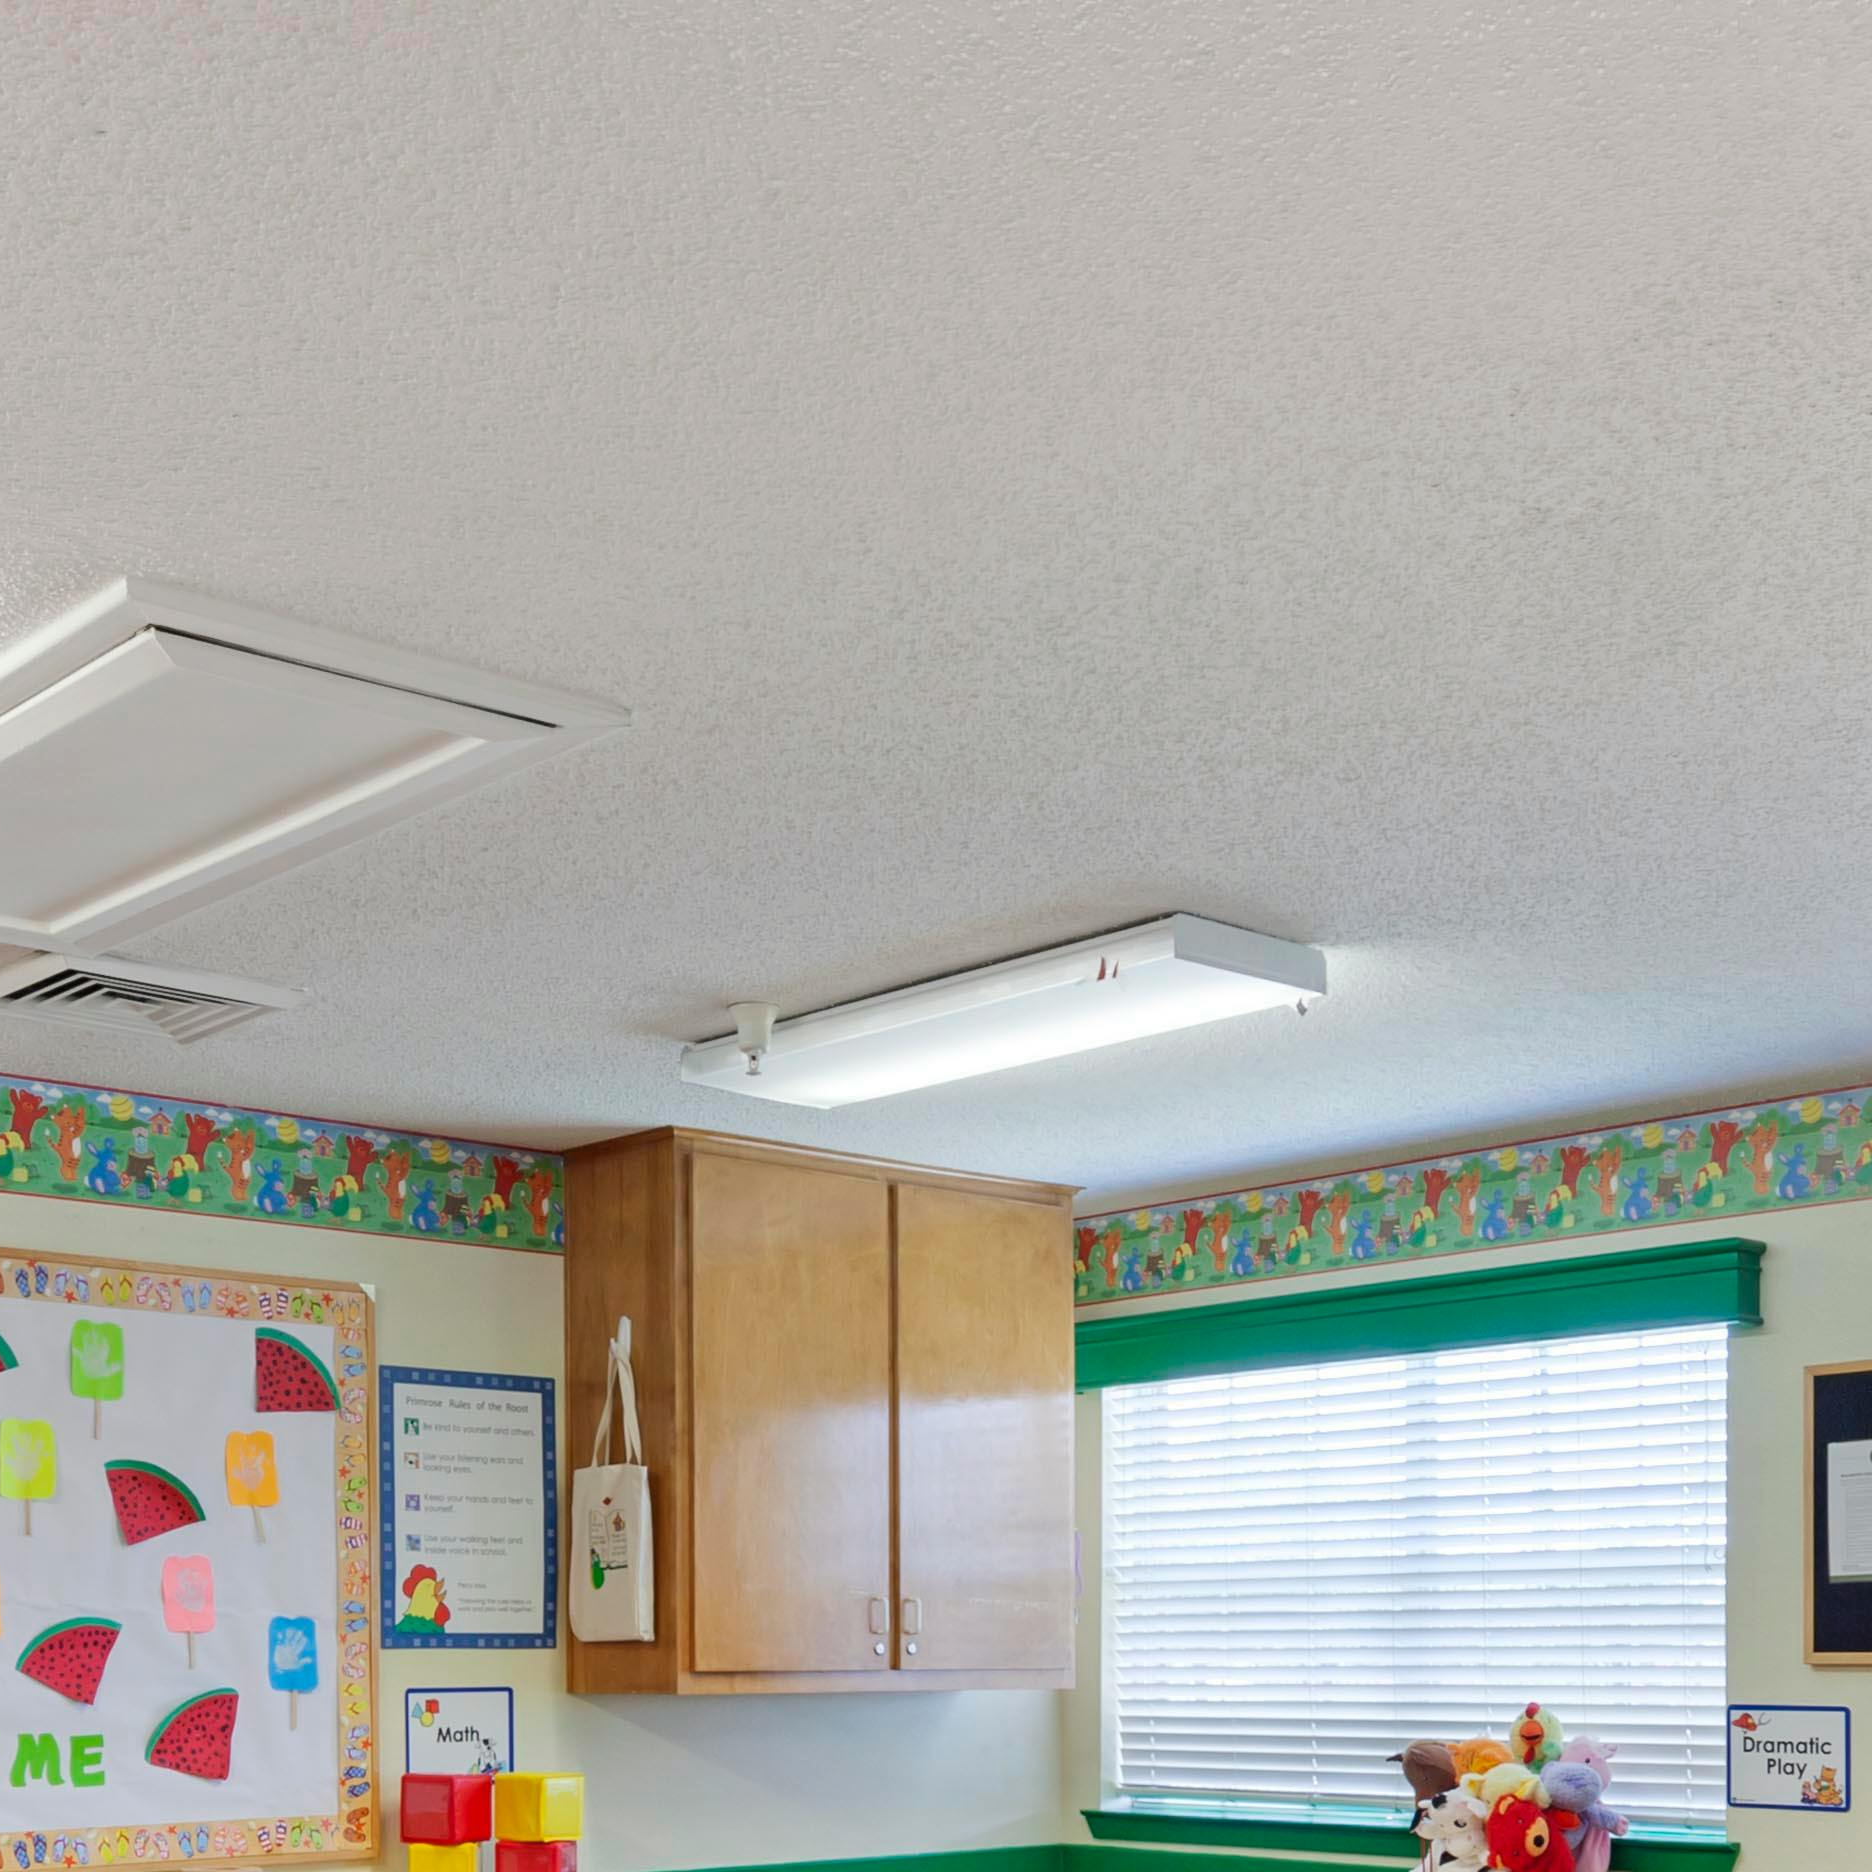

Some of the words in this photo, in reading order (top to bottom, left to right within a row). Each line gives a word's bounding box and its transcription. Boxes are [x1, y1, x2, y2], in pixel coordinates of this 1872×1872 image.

[406, 1396, 442, 1408] Primrose
[449, 1399, 472, 1410] Rules
[476, 1401, 485, 1411] of
[488, 1402, 502, 1412] the
[506, 1403, 529, 1414] Roost
[494, 1426, 509, 1436] and
[437, 1726, 480, 1743] Math
[1743, 1736, 1832, 1755] Dramatic
[1767, 1758, 1808, 1780] Play
